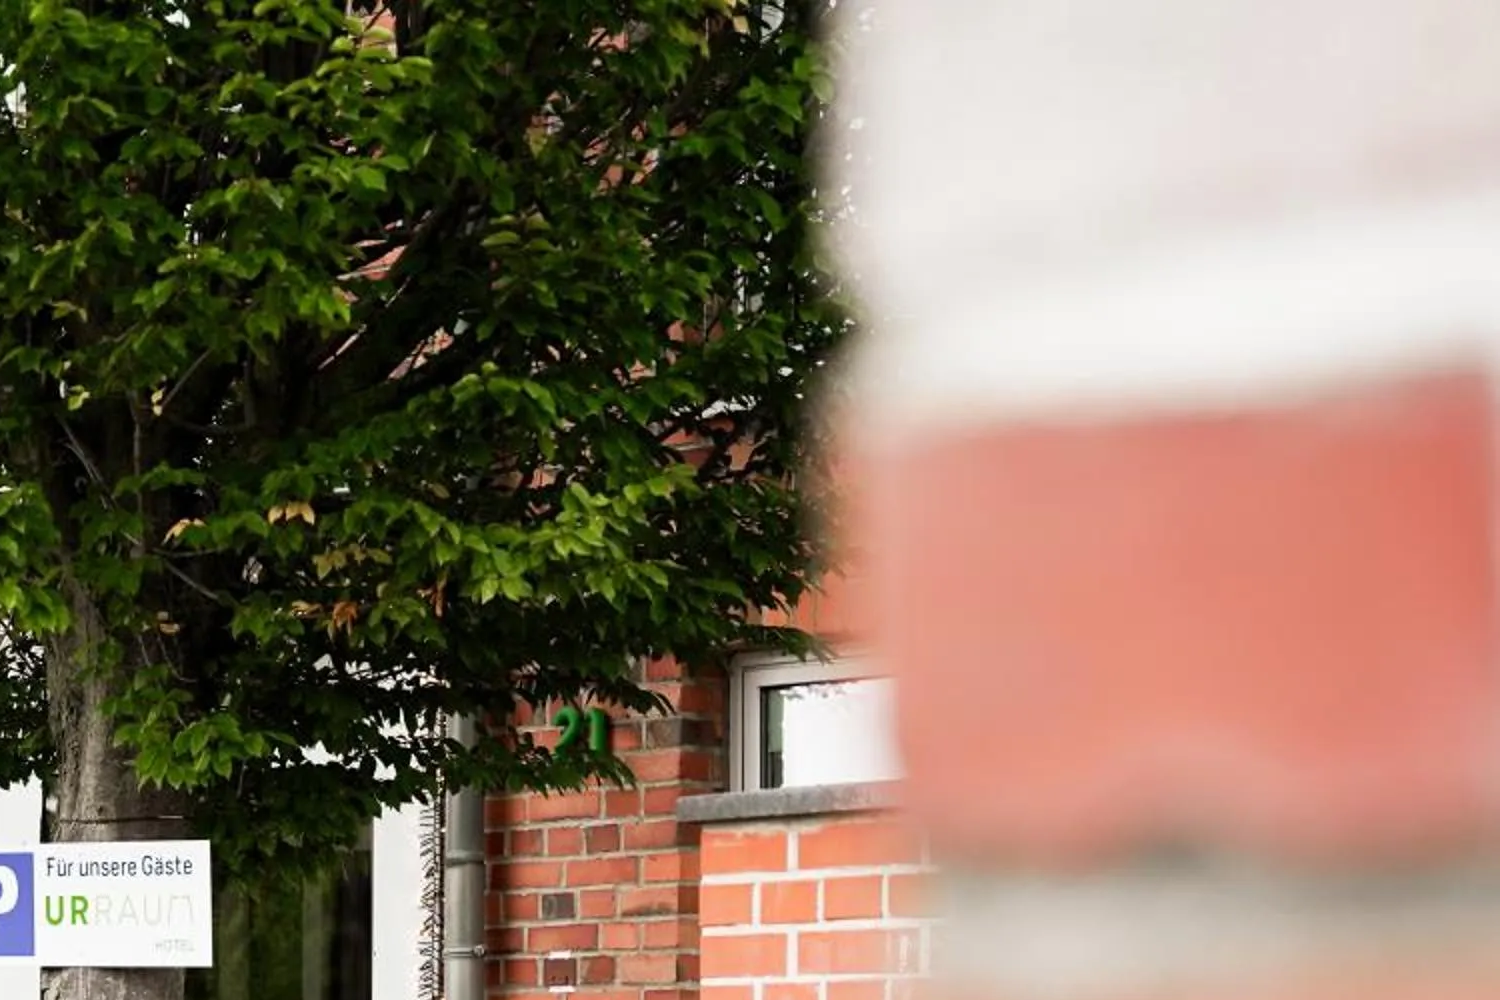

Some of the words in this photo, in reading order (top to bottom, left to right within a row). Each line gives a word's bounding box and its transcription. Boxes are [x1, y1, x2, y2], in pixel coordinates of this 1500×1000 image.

[552, 704, 606, 758] 21
[45, 856, 74, 878] Für
[79, 858, 137, 877] unsere
[141, 854, 193, 877] Gäste
[155, 938, 196, 953] HOTEL
